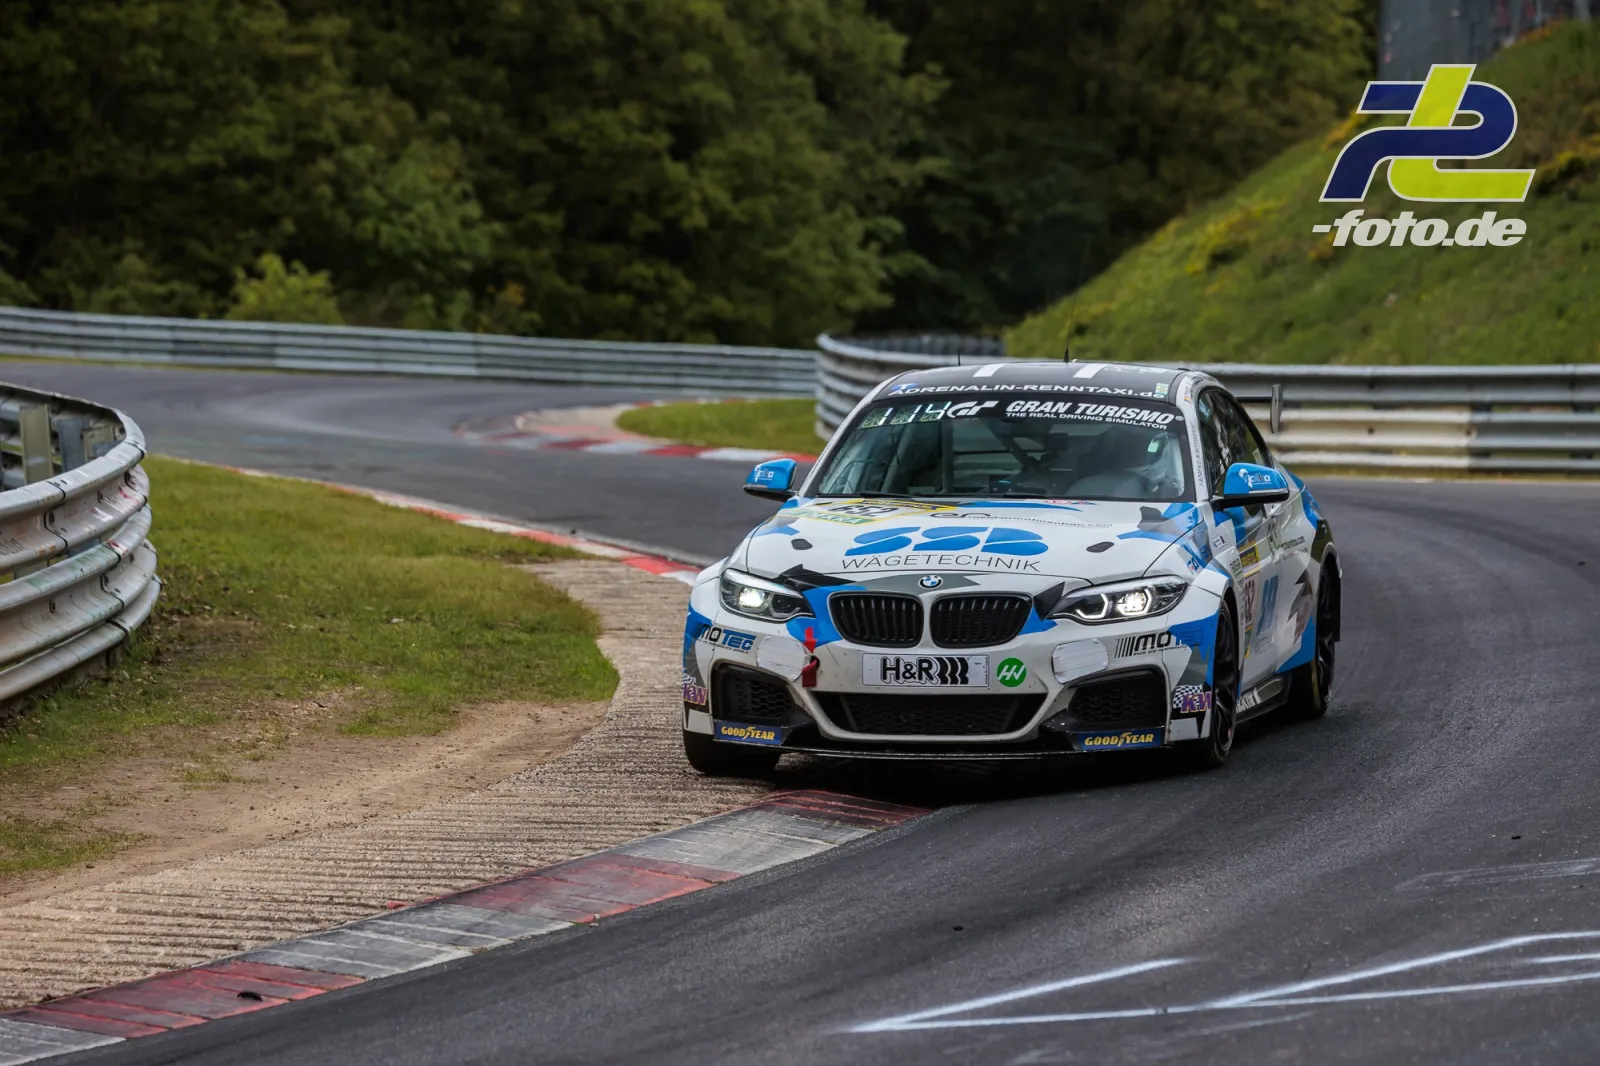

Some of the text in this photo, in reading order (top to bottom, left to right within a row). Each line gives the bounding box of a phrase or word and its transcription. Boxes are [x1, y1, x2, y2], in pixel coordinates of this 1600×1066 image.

[1006, 400, 1070, 414] GRAN
[1059, 413, 1103, 421] DRIVING
[1105, 417, 1168, 430] SIMULATOR
[844, 526, 1049, 557] SSB
[842, 554, 1041, 573] WÄGETECHNIK
[880, 656, 938, 685] H&R
[721, 726, 775, 740] GOODYEAR
[1084, 732, 1154, 747] GOODYEAR
